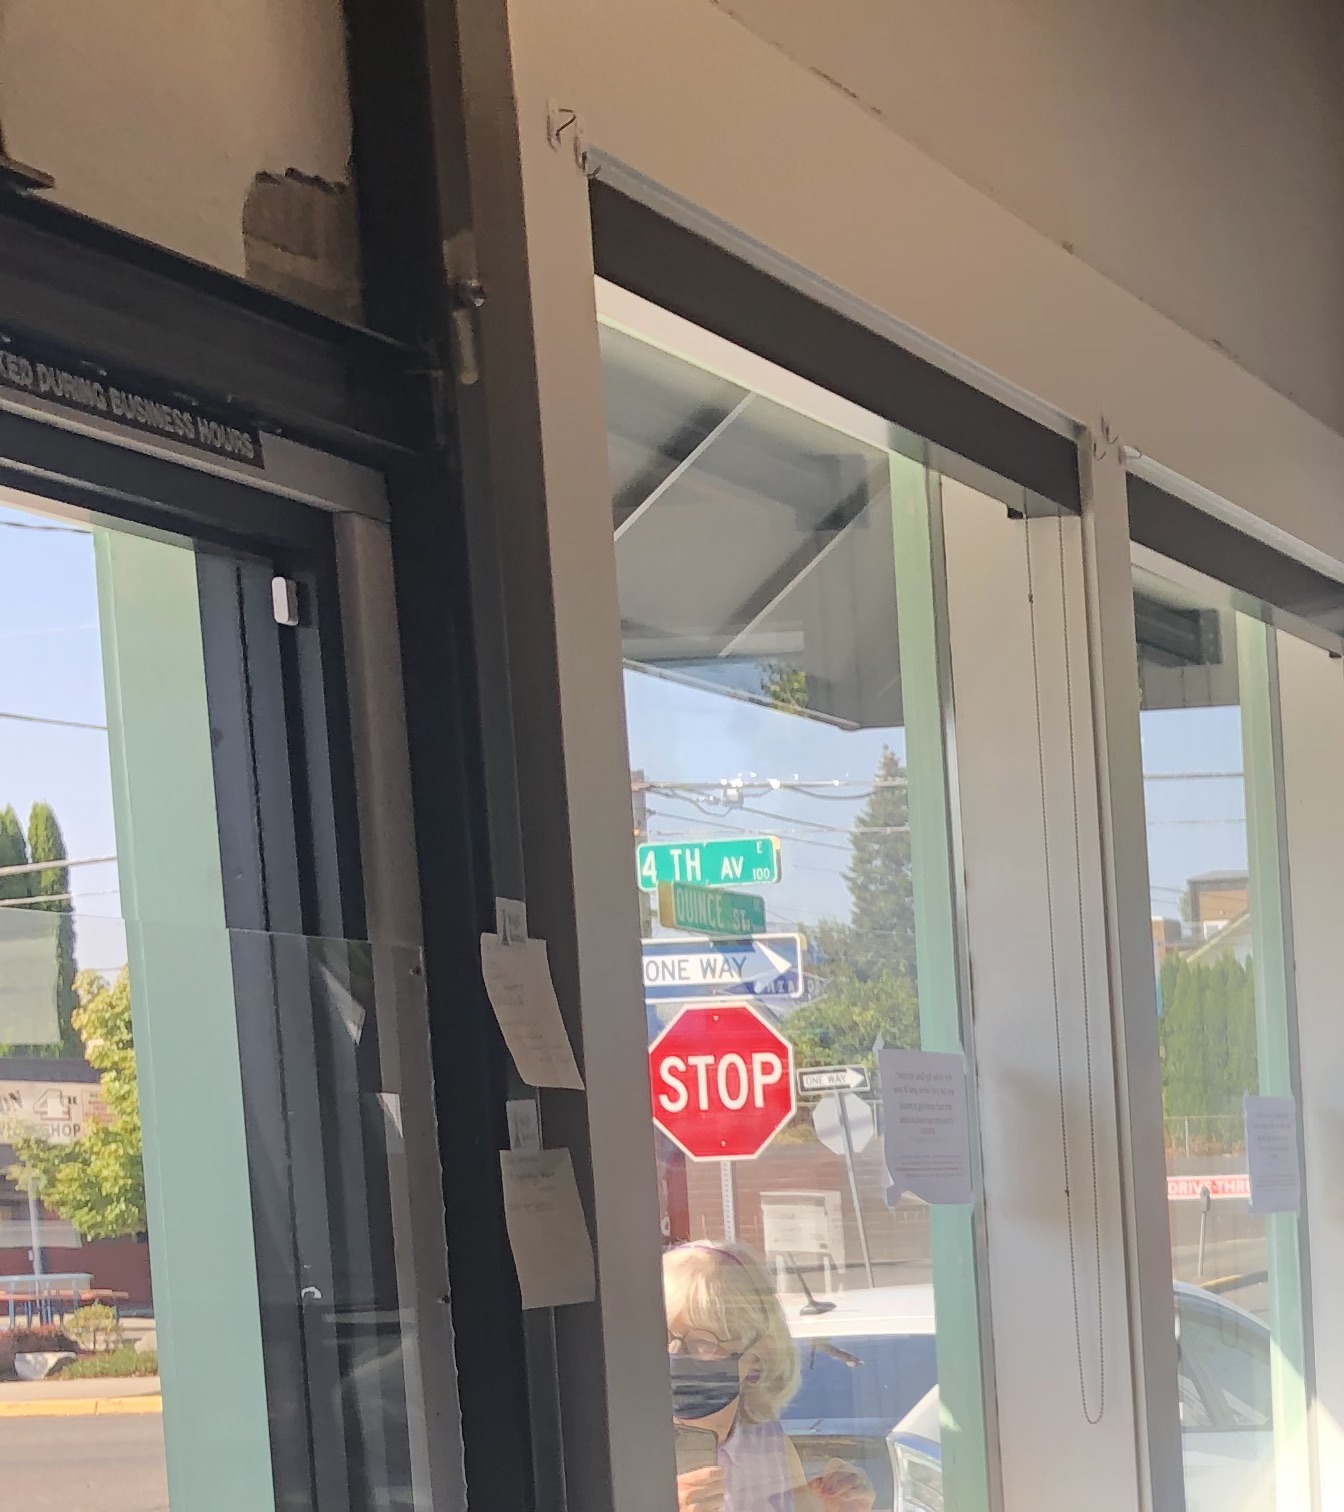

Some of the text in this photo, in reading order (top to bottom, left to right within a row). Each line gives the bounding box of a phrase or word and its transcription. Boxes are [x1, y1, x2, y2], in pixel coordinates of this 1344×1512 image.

[35, 362, 107, 411] DURING
[108, 386, 196, 440] BUSINESS
[197, 416, 254, 459] HOURS
[642, 848, 744, 884] 4 TH AV
[752, 867, 771, 881] 100
[676, 888, 725, 929] QUINCE
[646, 956, 747, 982] ONE WAY
[659, 1052, 783, 1113] STOP
[805, 1072, 848, 1087] ONE WAY
